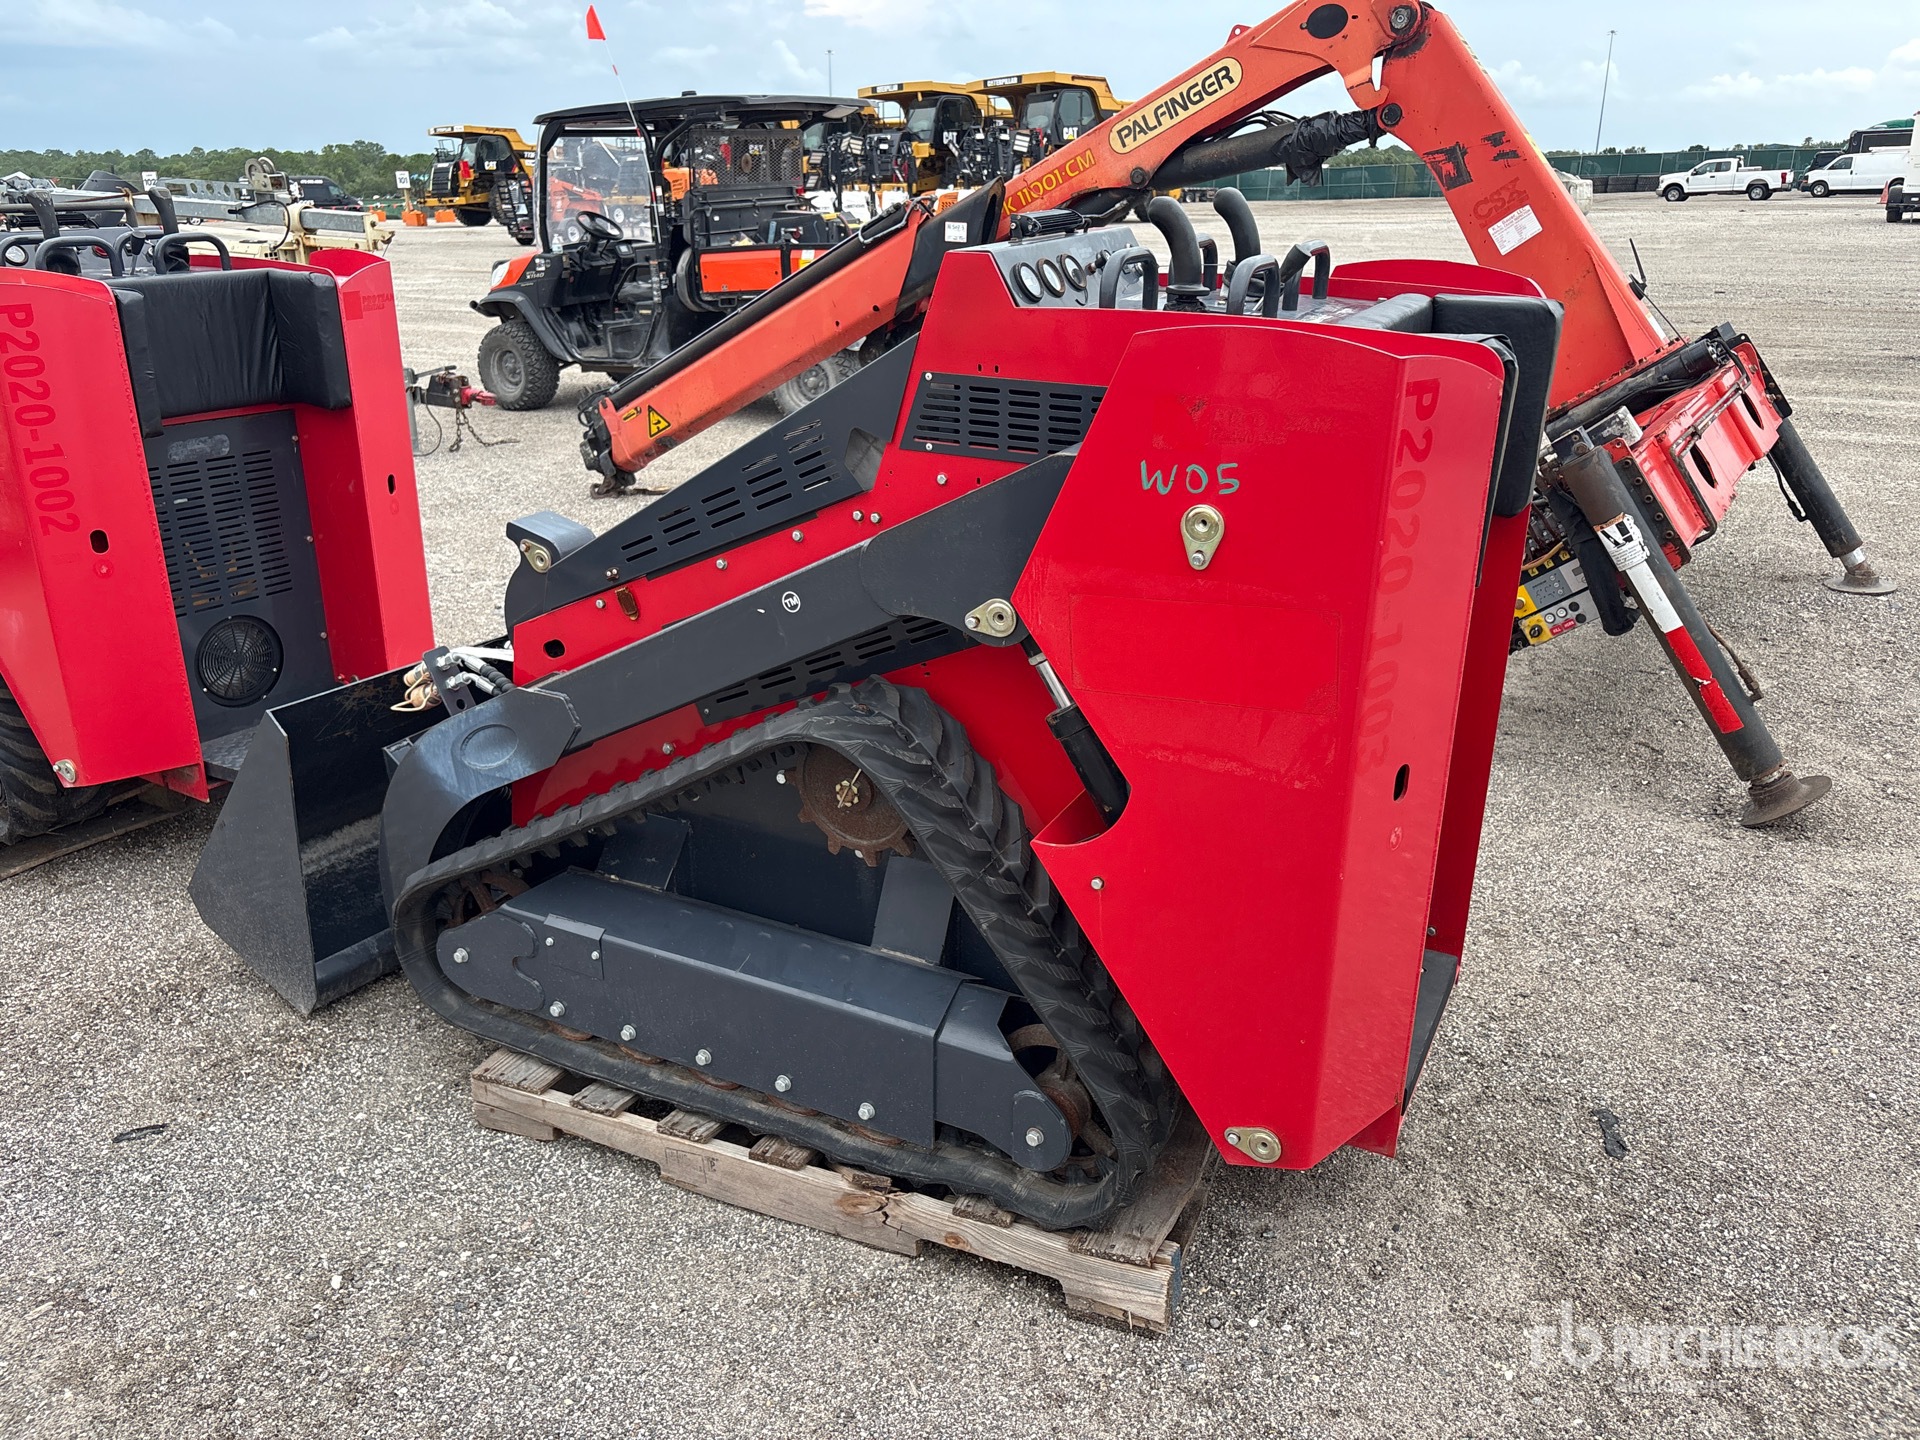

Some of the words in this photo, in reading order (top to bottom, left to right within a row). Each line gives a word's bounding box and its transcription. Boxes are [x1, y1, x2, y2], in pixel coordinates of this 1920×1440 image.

[1116, 65, 1236, 149] PALFINGER
[943, 131, 958, 145] CAT
[1062, 127, 1079, 140] CAT
[484, 161, 497, 170] CAT
[1473, 176, 1528, 221] CSX
[0, 303, 81, 536] P2020-1002
[784, 595, 800, 608] TM
